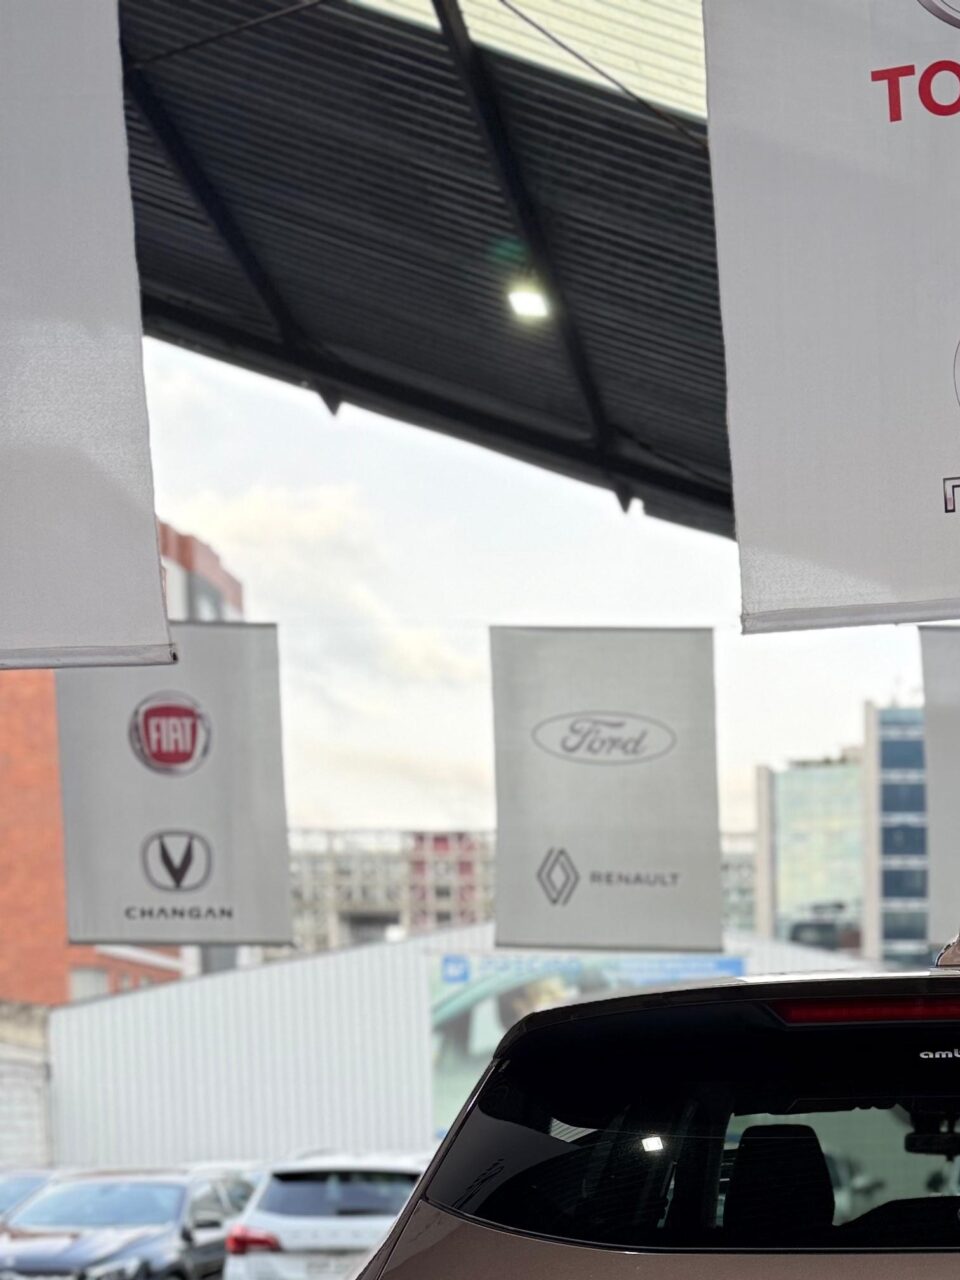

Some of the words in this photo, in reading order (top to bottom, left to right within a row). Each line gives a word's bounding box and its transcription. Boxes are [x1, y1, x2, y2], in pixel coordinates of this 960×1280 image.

[150, 716, 194, 753] FIAT
[561, 718, 648, 755] Ford
[590, 870, 679, 886] RENAULT
[124, 906, 234, 920] CHANGAN
